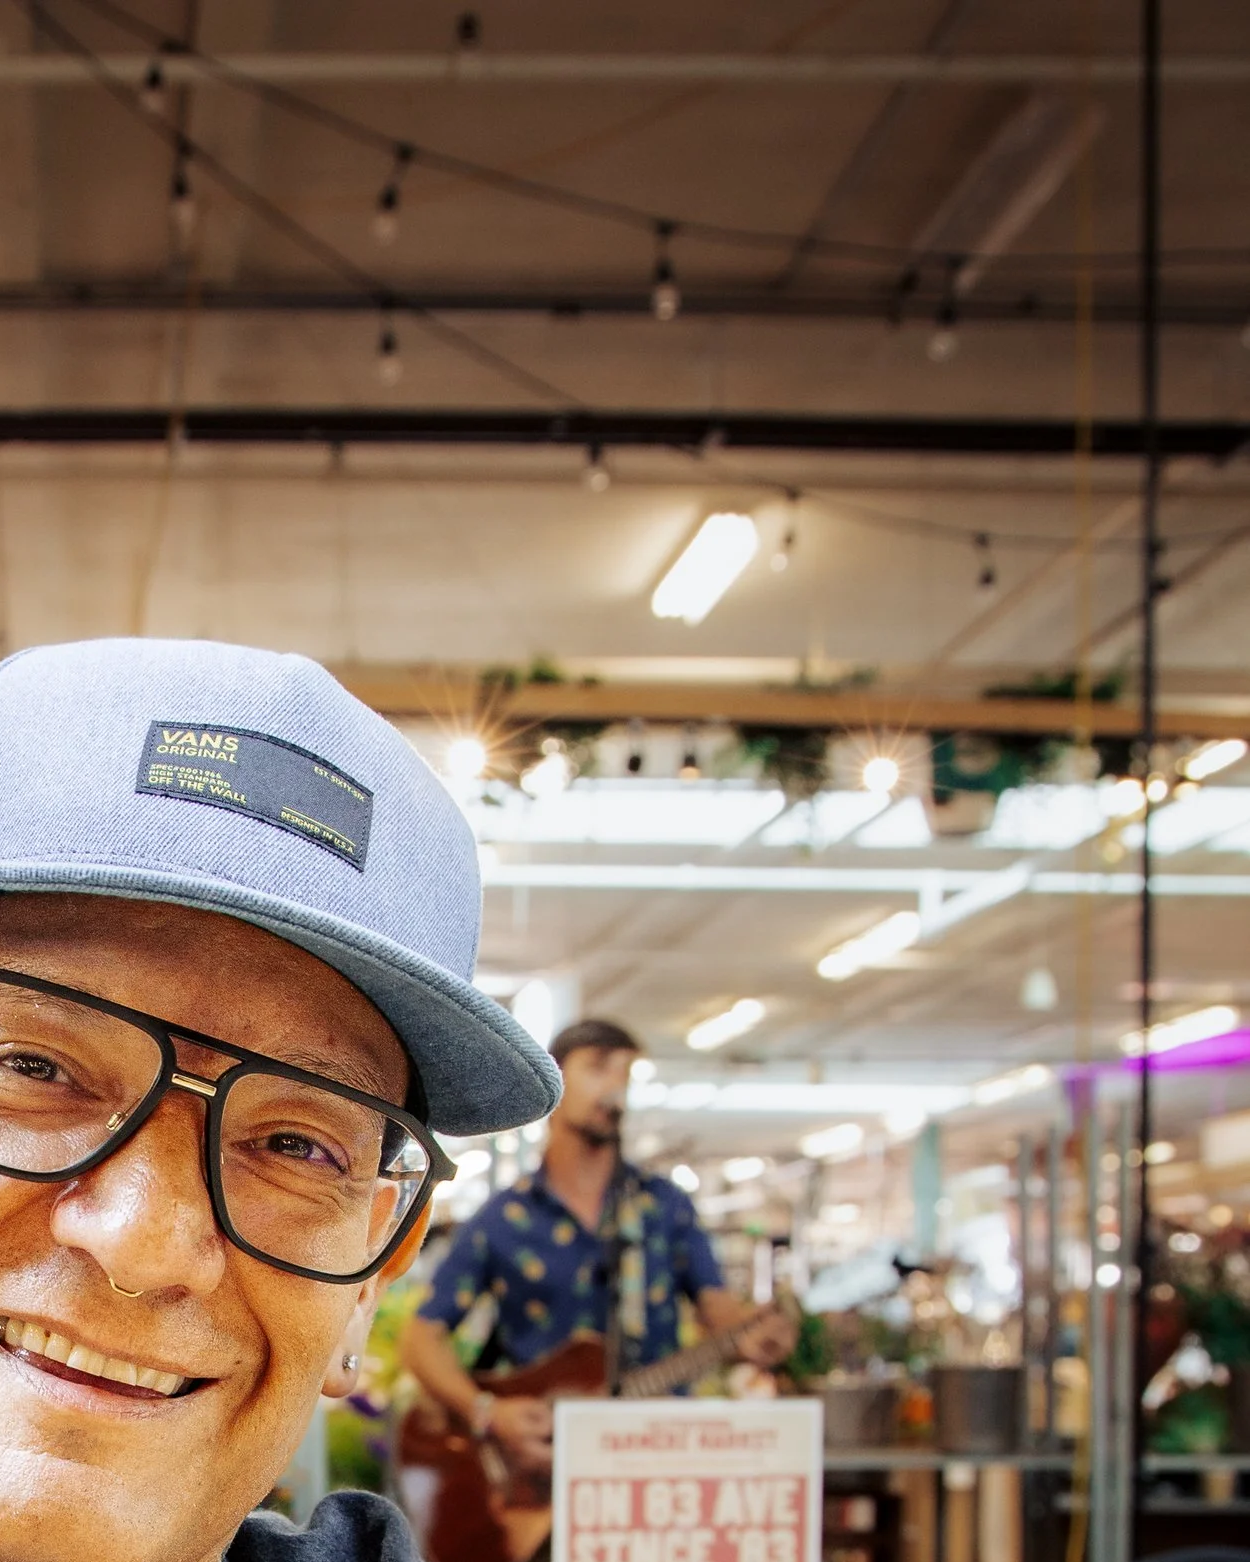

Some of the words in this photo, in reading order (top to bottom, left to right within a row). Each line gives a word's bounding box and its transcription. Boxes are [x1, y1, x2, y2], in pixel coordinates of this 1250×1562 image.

[163, 730, 239, 752] VANS
[156, 745, 238, 764] ORIGINAL
[148, 775, 174, 785] OFF
[178, 779, 206, 792] THE
[209, 785, 247, 805] WALL
[176, 772, 231, 788] STANDARD
[280, 811, 321, 834] DESIGNED
[322, 830, 333, 841] IN
[573, 1480, 632, 1528] ON
[712, 1478, 800, 1527] AVE
